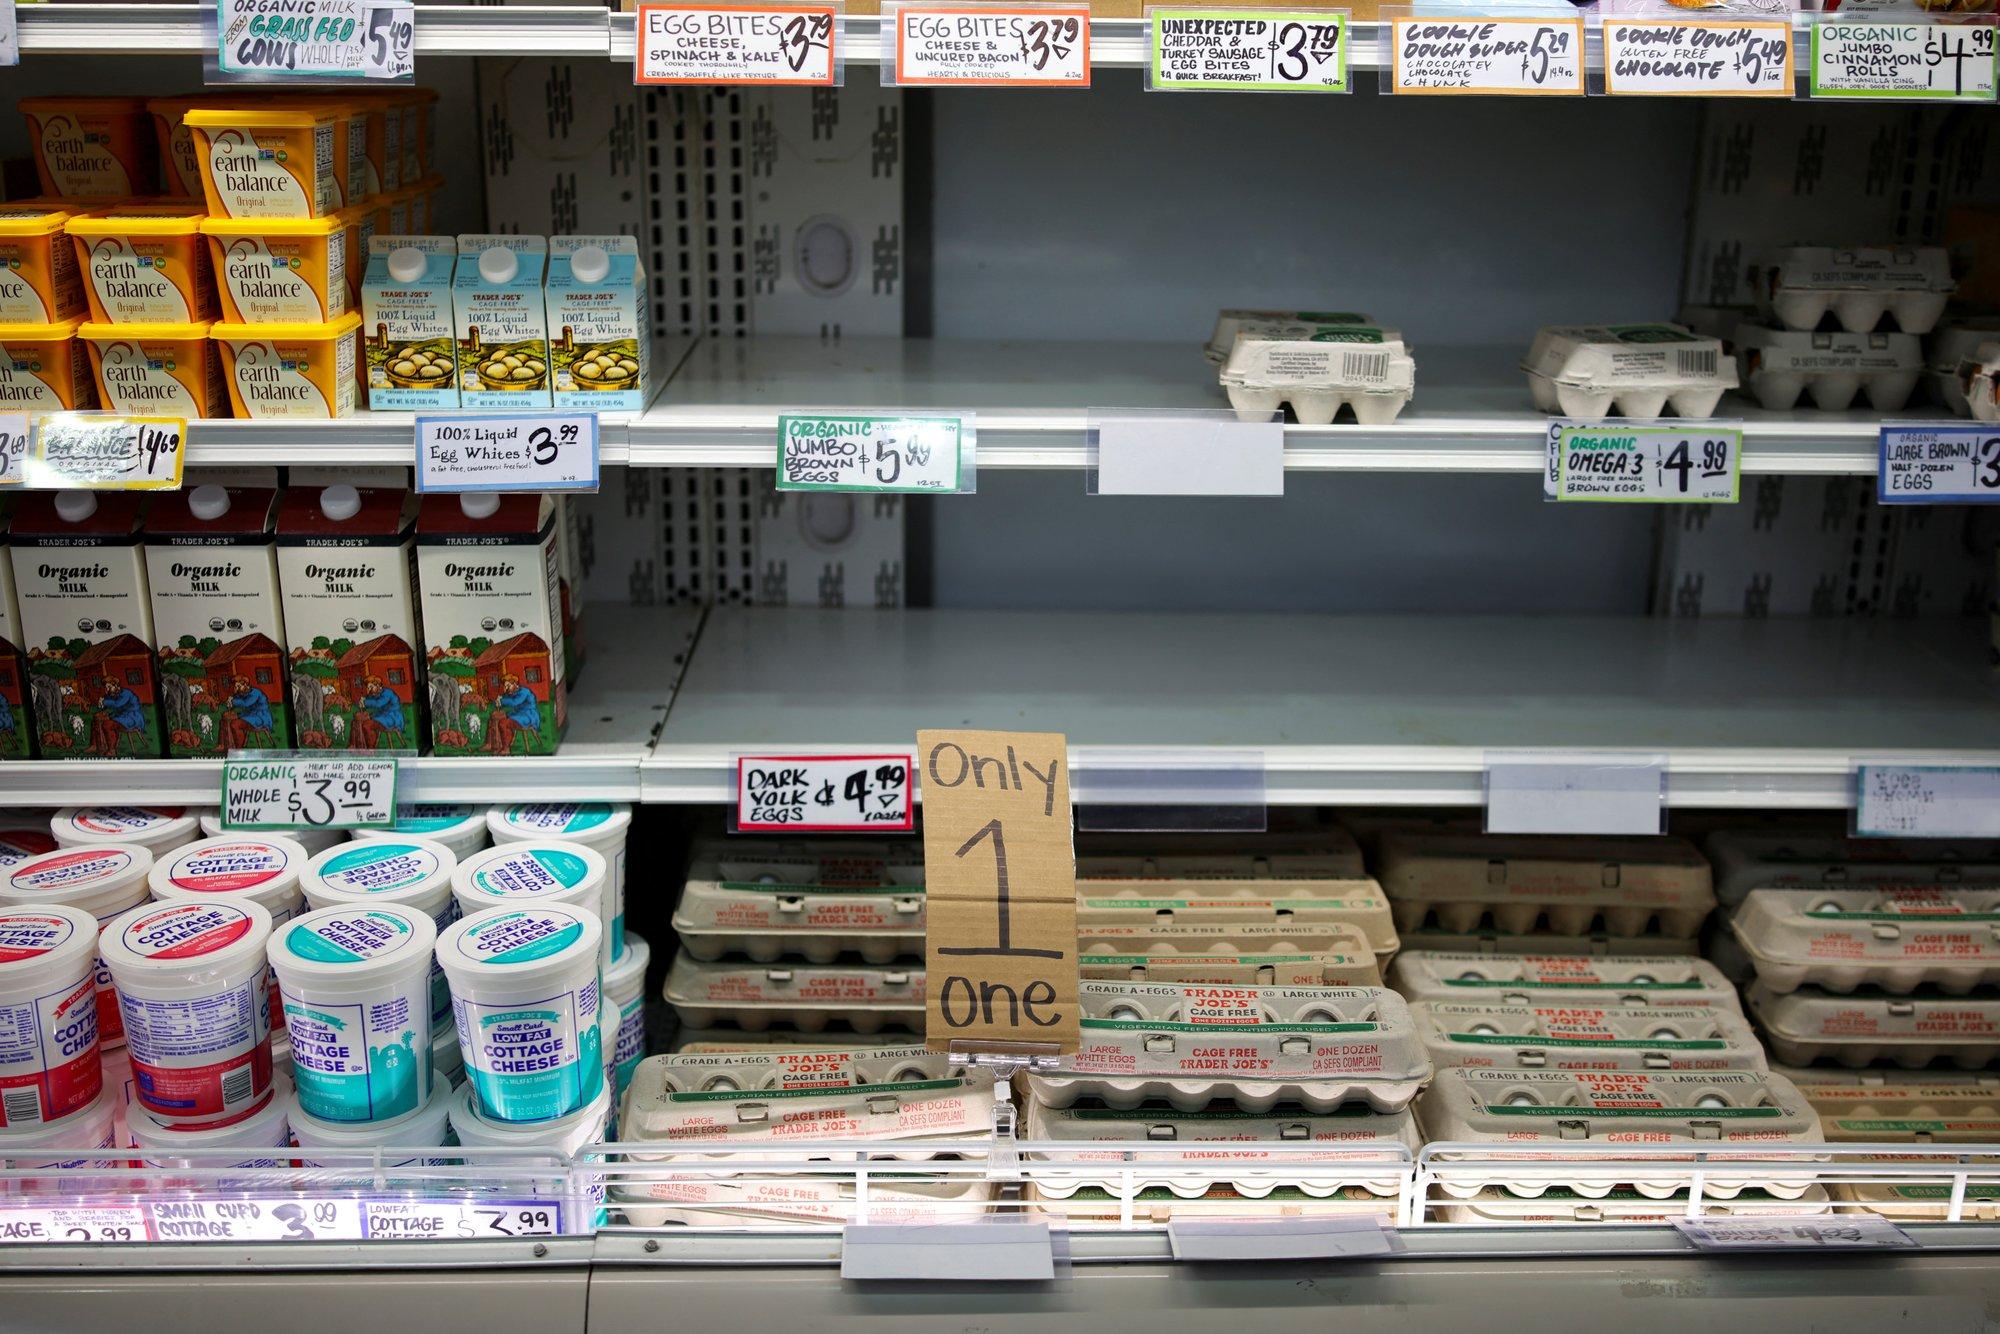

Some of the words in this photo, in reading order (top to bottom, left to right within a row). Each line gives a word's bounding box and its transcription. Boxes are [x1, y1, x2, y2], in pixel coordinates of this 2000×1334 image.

[234, 0, 315, 13] ORGANIC
[318, 0, 355, 14] MILK
[251, 15, 313, 42] GRASS
[315, 17, 355, 41] FED
[650, 14, 700, 34] EGG
[708, 15, 783, 35] BITES
[907, 18, 950, 38] EGG
[958, 18, 1023, 38] BITES
[1161, 20, 1267, 35] UNEXPECTED
[1406, 24, 1497, 42] COOKIE
[1615, 27, 1687, 45] COOKIE
[1690, 28, 1752, 48] DOUGH
[1823, 27, 1917, 41] ORGANIC
[926, 41, 980, 50] CHEESE
[986, 42, 997, 50] &
[1164, 34, 1221, 47] CHEDDAR
[237, 38, 297, 70] COWS
[301, 45, 340, 64] WHOLE
[1160, 49, 1208, 59] TURKEY
[1209, 48, 1265, 59] SAUSAGE
[1404, 43, 1465, 59] DOUGH
[1469, 41, 1528, 58] SUPER
[1620, 47, 1667, 58] GLUTEN
[1674, 49, 1709, 59] FREE
[1839, 43, 1892, 53] JUMBO
[651, 50, 721, 61] SPINACH
[727, 52, 736, 61] &
[743, 52, 779, 62] KALE
[916, 53, 974, 62] UNCURED
[979, 53, 1019, 62] BACON
[1824, 53, 1921, 66] CINNAMON
[1172, 60, 1197, 70] EGG
[1205, 61, 1250, 70] BITES
[1615, 60, 1725, 79] CHOCOLATE
[1847, 66, 1898, 77] ROLLS
[1176, 72, 1199, 80] QUICK
[1203, 73, 1261, 81] BREAKFAST!
[1409, 69, 1471, 77] CHOCOLATE
[1404, 79, 1470, 87] CHUNK
[215, 155, 257, 172] earth
[226, 174, 287, 192] balance
[230, 262, 270, 279] earth
[240, 281, 300, 298] balance
[117, 302, 145, 314] Original
[251, 302, 279, 314] Original
[403, 310, 435, 322] Liquid
[495, 313, 527, 324] Liquid
[411, 322, 448, 332] Whites
[502, 325, 540, 334] Whites
[240, 366, 279, 382] earth
[250, 383, 308, 400] balance
[789, 420, 872, 437] ORGANIC
[435, 427, 471, 440] 100%
[475, 427, 517, 444] Liquid
[787, 439, 856, 456] JUMBO
[1569, 436, 1636, 451] ORGANIC
[431, 446, 458, 463] Egg
[465, 446, 520, 460] Whites
[1887, 445, 1923, 461] LARGE
[1929, 443, 1970, 459] BROWN
[785, 457, 853, 472] BROWN
[789, 471, 839, 483] EGGS
[1893, 474, 1932, 490] EGGS
[1567, 483, 1610, 493] BROWN
[1615, 484, 1645, 493] EGGS
[38, 563, 109, 582] Organic
[170, 563, 242, 581] Organic
[305, 563, 376, 582] Organic
[444, 562, 515, 581] Organic
[58, 583, 88, 593] MILK
[191, 582, 220, 592] MILK
[325, 583, 354, 593] MILK
[464, 582, 493, 592] MILK
[228, 767, 296, 780] ORGANIC
[748, 769, 809, 790] DARK
[929, 742, 1058, 816] Only
[229, 789, 281, 806] WHOLE
[750, 790, 807, 806] YOLK
[228, 808, 261, 824] MILK
[750, 807, 803, 823] EGGS
[186, 856, 273, 870] COTTAGE
[190, 864, 266, 876] CHEESE
[938, 819, 1063, 958] 1
[818, 905, 845, 914] CAGE
[850, 905, 874, 913] FREE
[807, 914, 849, 924] TRADER
[1914, 934, 1943, 943] CAGE
[1947, 934, 1971, 943] FREE
[1904, 944, 1946, 954] TRADER
[1087, 985, 1125, 994] GRADE
[1184, 989, 1258, 999] TRADER
[940, 976, 1062, 1027] One
[495, 1032, 521, 1042] LOW
[526, 1029, 549, 1040] FAT
[289, 1033, 349, 1058] COTTAGE
[1090, 1045, 1121, 1054] LARGE
[1343, 1044, 1378, 1055] DOZEN
[293, 1052, 345, 1072] CHEESE
[1075, 1054, 1106, 1062] WHITE
[1109, 1055, 1135, 1063] EGGS
[1344, 1056, 1382, 1068] COMPLIANT
[1480, 1072, 1518, 1082] GRADE
[1672, 1075, 1707, 1084] LARGE
[1709, 1075, 1745, 1084] WHITE
[903, 1101, 928, 1112] ONE
[927, 1110, 966, 1123] COMPLIANT
[705, 1125, 728, 1134] EGGS
[1507, 1130, 1539, 1141] LARGE
[1729, 1131, 1752, 1141] ONE
[1755, 1130, 1788, 1139] DOZEN
[159, 1221, 233, 1237] COTTAGE
[370, 1215, 444, 1231] COTTAGE
